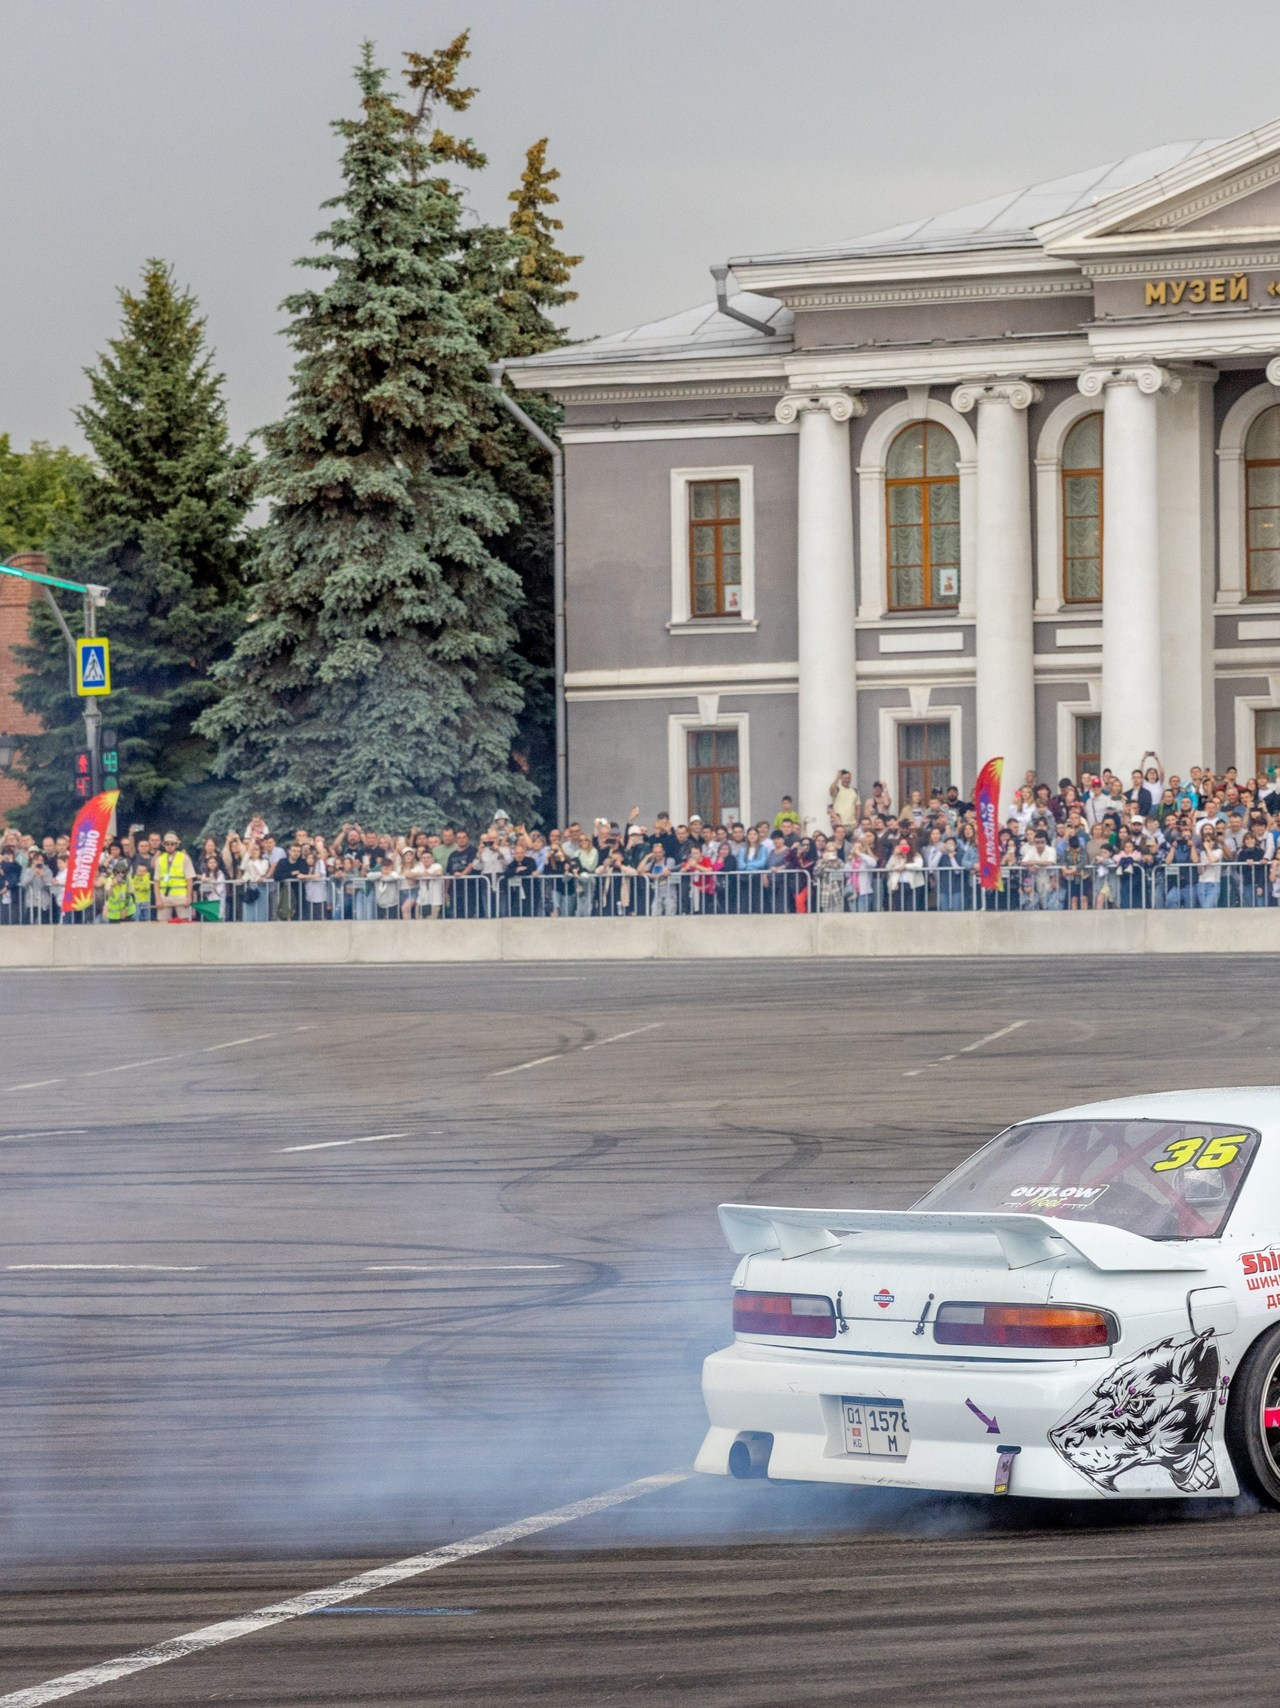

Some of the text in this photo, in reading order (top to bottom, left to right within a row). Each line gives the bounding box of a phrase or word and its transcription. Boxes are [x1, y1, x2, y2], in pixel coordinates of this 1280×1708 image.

[1145, 272, 1248, 305] МУЗЕЙ
[77, 829, 100, 888] ВЫГОДНО
[1150, 1133, 1250, 1173] 35
[1010, 1187, 1102, 1198] OUTLOW
[847, 1407, 862, 1425] 01
[853, 1438, 862, 1448] KG
[887, 1434, 898, 1452] M
